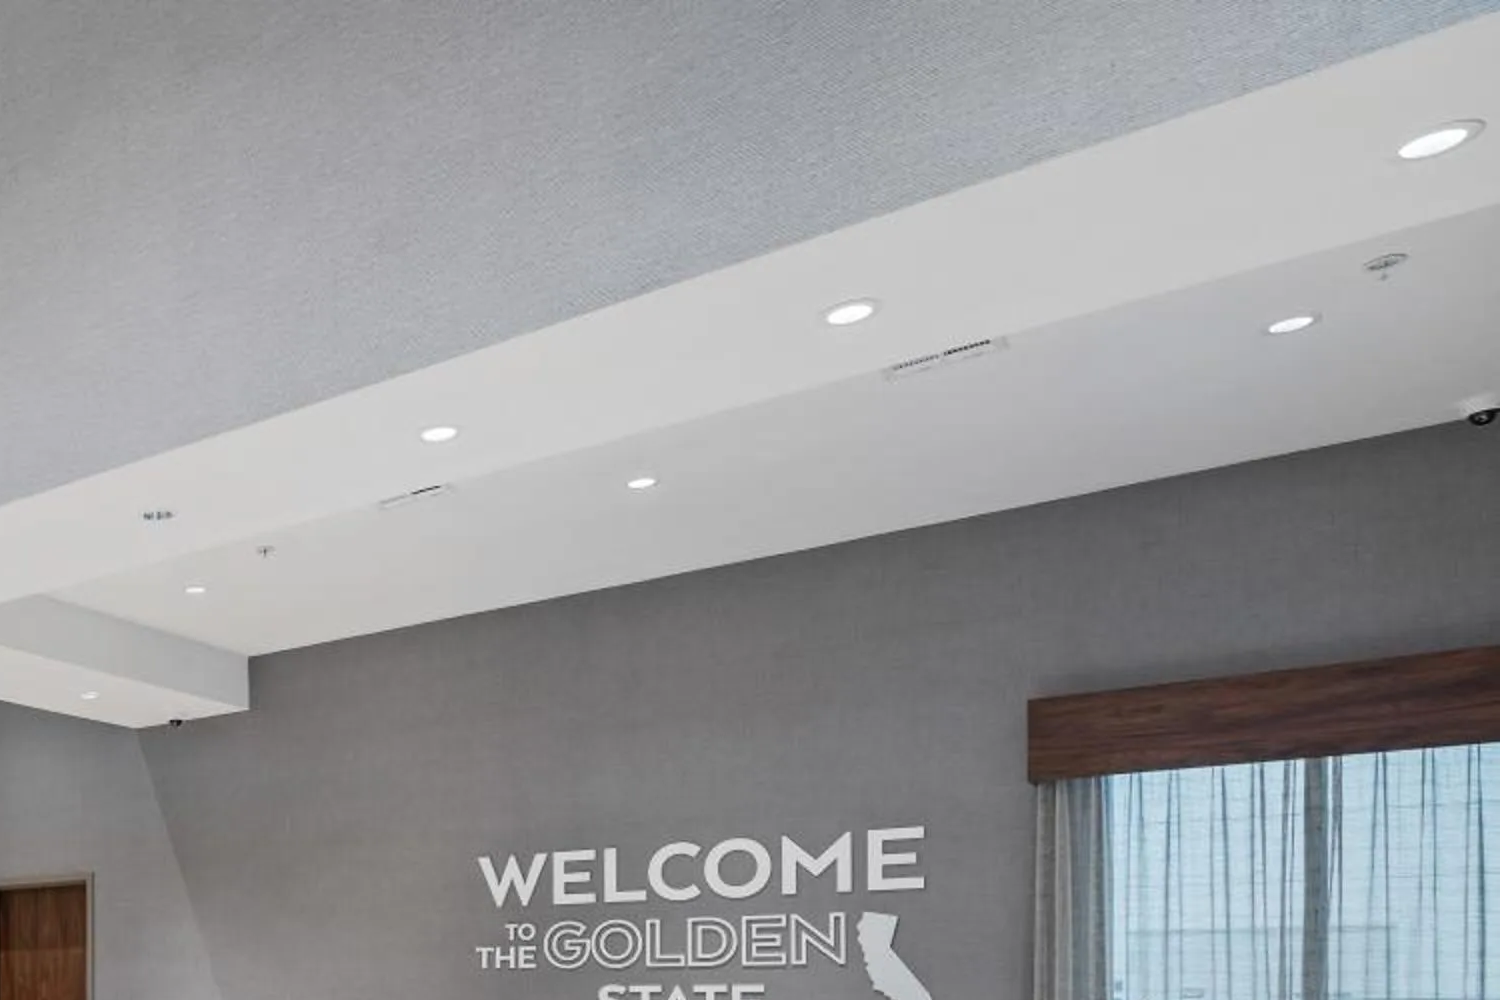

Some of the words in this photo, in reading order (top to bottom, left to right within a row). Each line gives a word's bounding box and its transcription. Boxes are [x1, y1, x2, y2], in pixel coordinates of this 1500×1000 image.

[477, 825, 926, 908] WELCOME
[475, 945, 538, 970] THE
[543, 911, 847, 970] GOLDEN
[504, 923, 537, 942] TO
